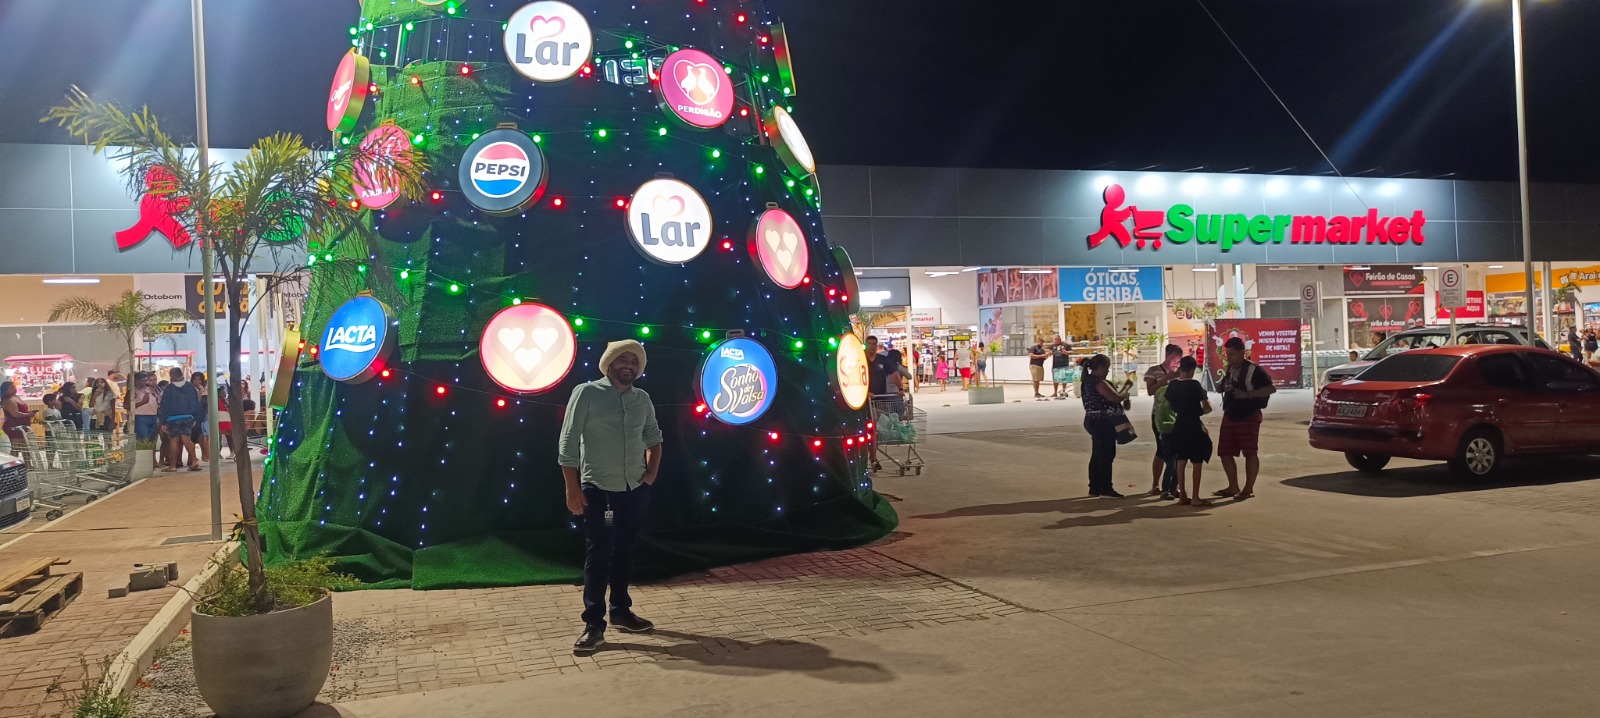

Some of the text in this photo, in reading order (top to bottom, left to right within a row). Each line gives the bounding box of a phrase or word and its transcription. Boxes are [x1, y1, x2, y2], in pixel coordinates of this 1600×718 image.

[515, 33, 580, 67] Lar
[677, 104, 723, 119] PERDIGÃO
[474, 161, 526, 178] PEPSI
[640, 212, 701, 248] Lar
[1165, 203, 1426, 251] Supermarket
[1085, 267, 1137, 286] ÓTICAS
[1365, 271, 1416, 280] Feirão de Casas
[1082, 282, 1144, 302] GERIBÁ
[324, 324, 377, 352] LACTA
[720, 347, 745, 360] LACTA
[713, 364, 760, 414] Sonho
[743, 384, 752, 394] de
[728, 385, 765, 414] Valsa
